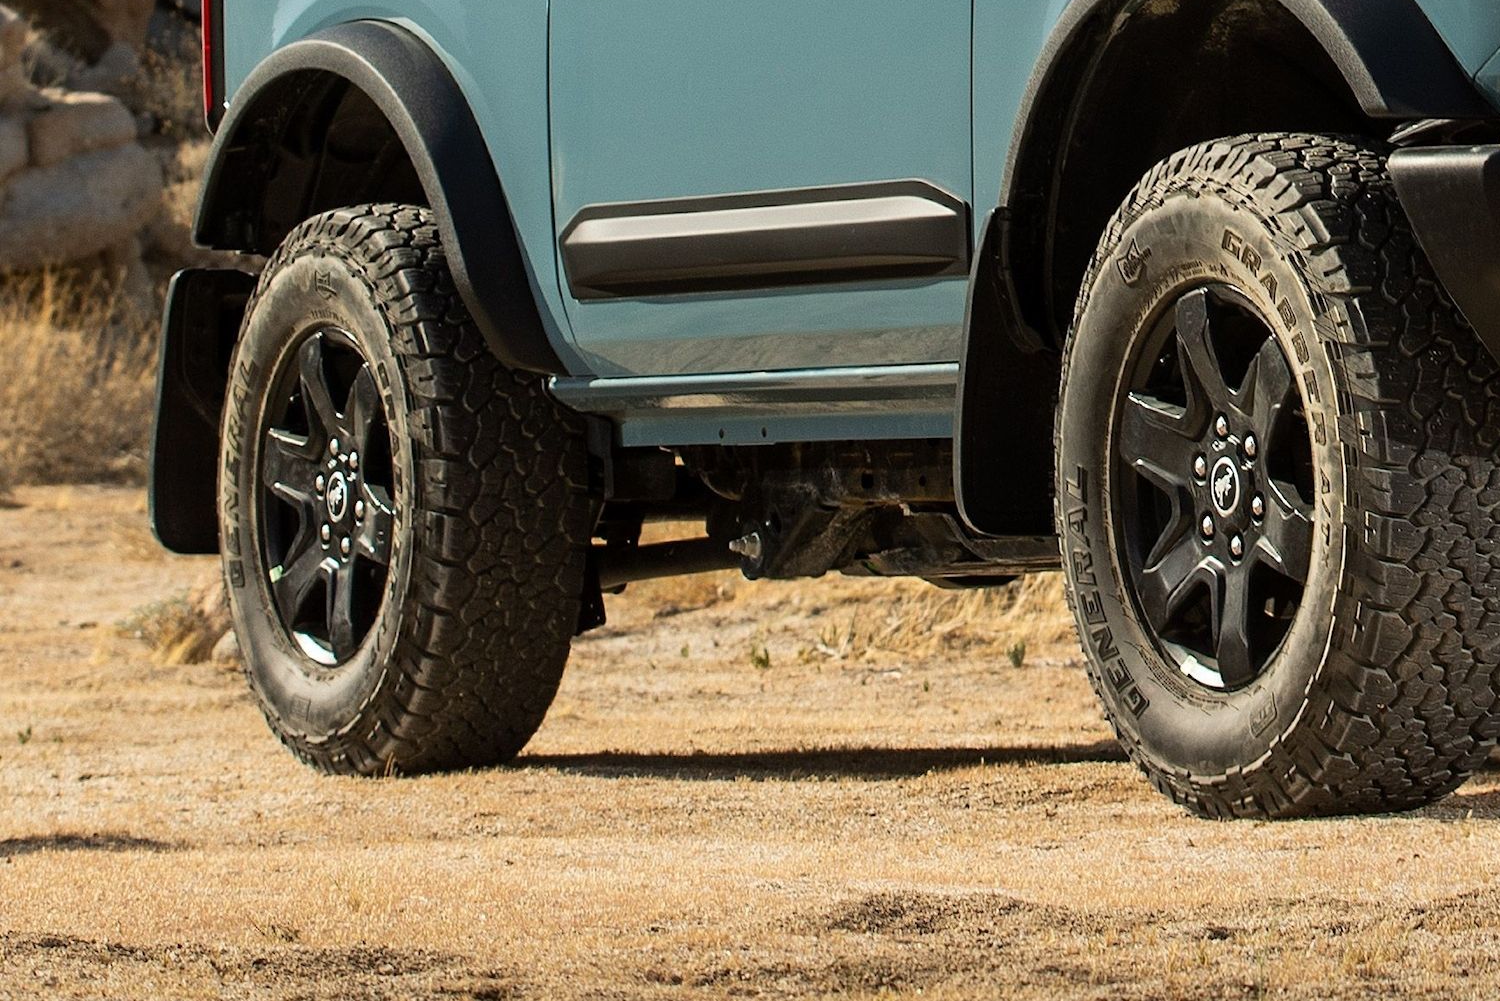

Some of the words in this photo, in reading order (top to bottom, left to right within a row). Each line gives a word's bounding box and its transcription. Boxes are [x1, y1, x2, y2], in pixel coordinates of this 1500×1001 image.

[1221, 228, 1327, 447] GRABBER
[223, 358, 259, 589] GENERAL
[1066, 464, 1150, 720] GENERAL
